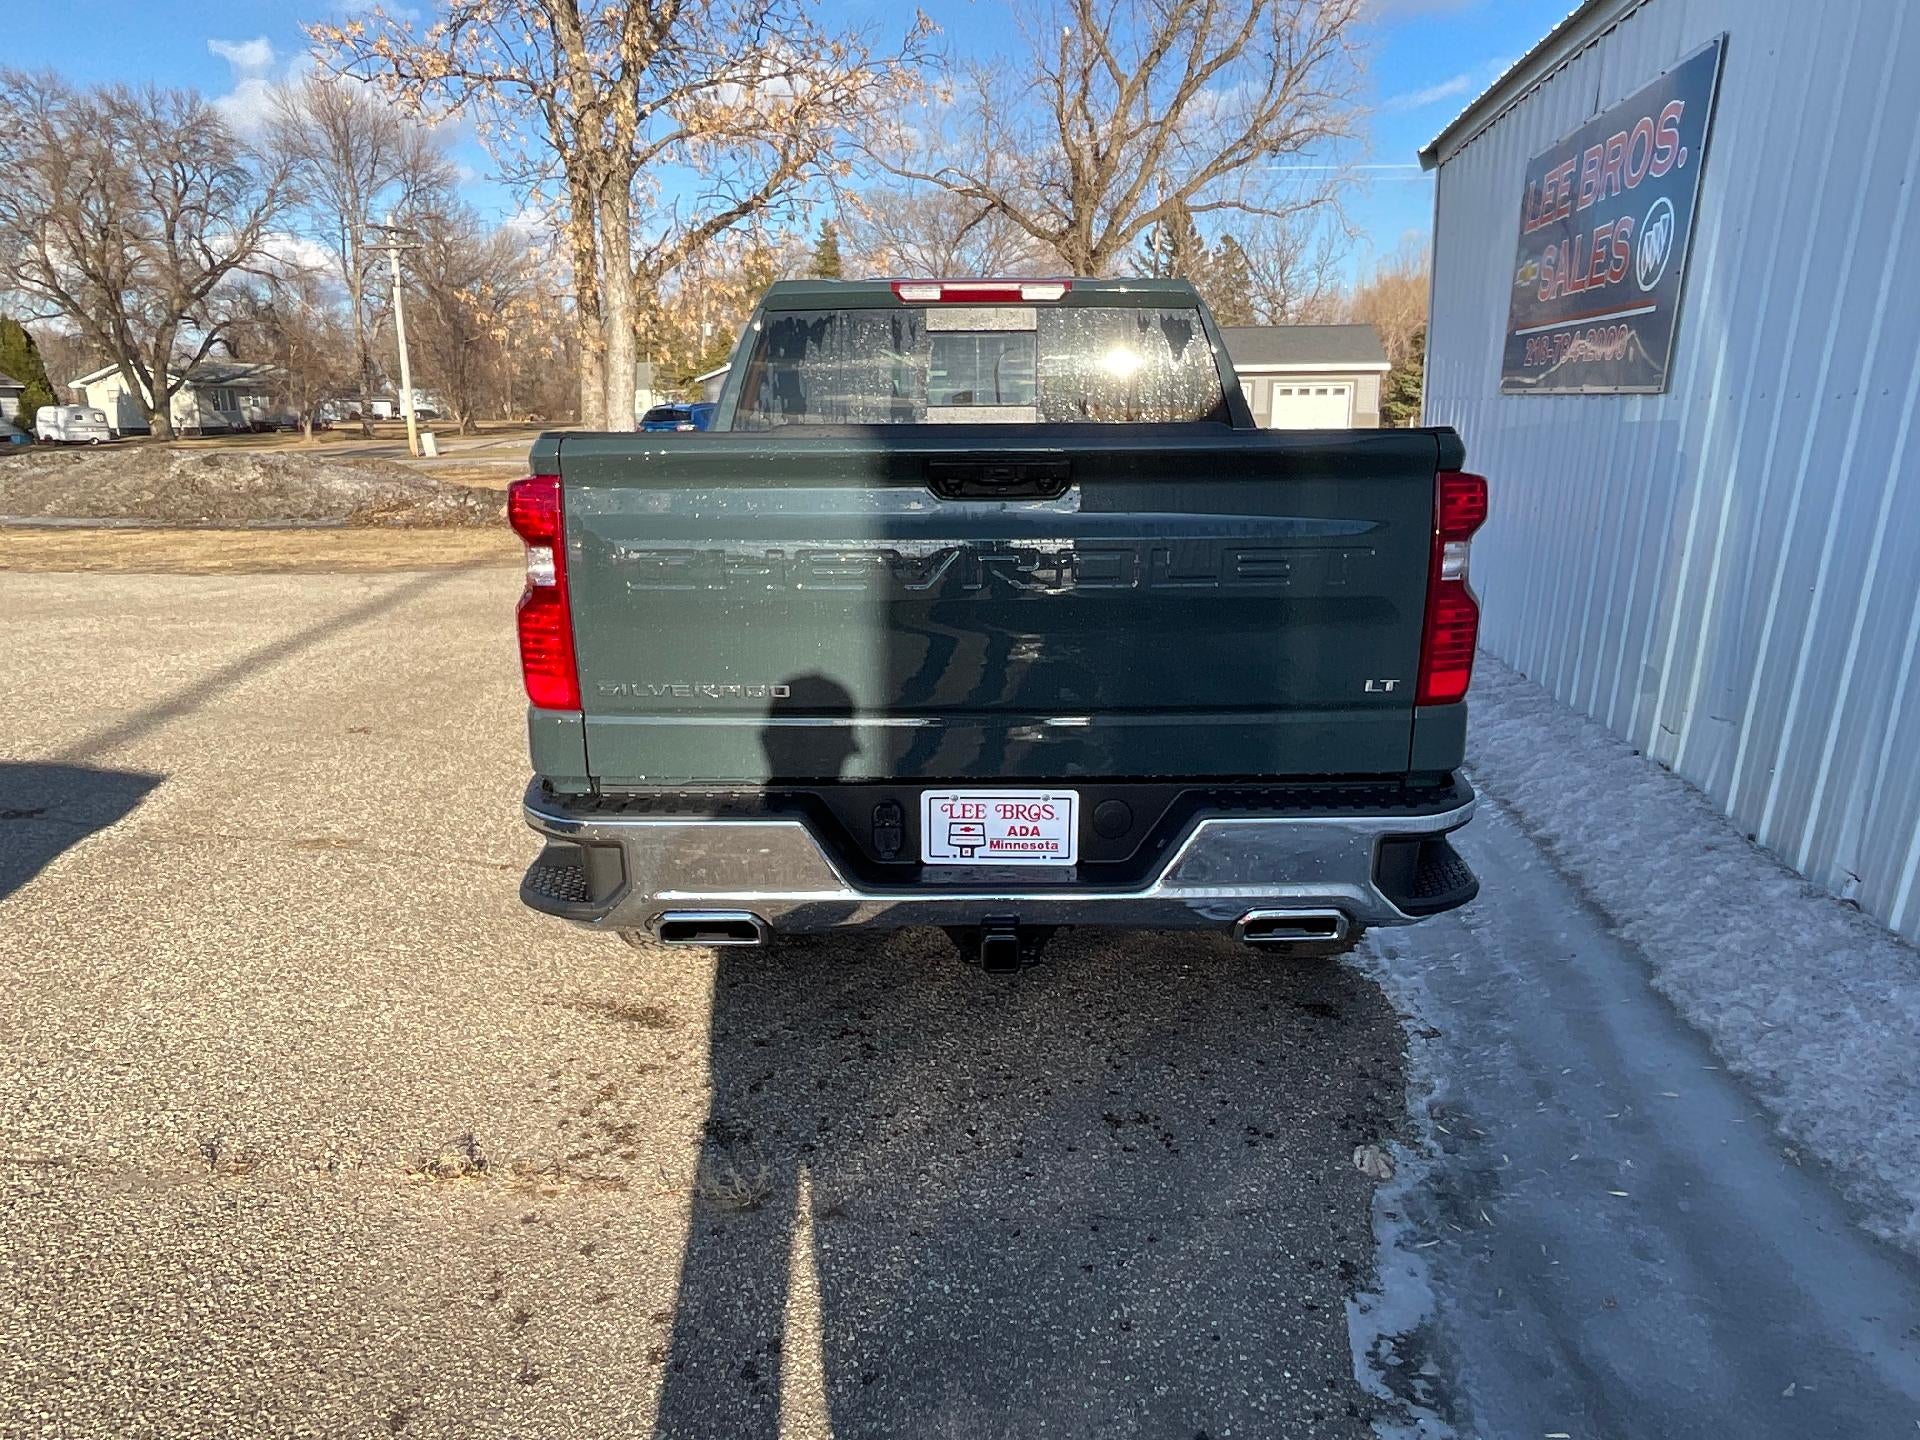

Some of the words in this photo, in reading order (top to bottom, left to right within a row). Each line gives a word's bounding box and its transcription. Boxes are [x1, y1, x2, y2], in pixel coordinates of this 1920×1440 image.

[1523, 155, 1578, 235] LEE
[1576, 101, 1687, 212] BROS.
[1537, 215, 1635, 302] SALES
[622, 547, 1375, 592] CHEVROLET
[598, 683, 791, 698] SILVERADO
[1364, 679, 1401, 692] LT
[940, 803, 987, 819] LEE
[1006, 825, 1041, 837] ADA
[988, 840, 1059, 850] Minnesota
